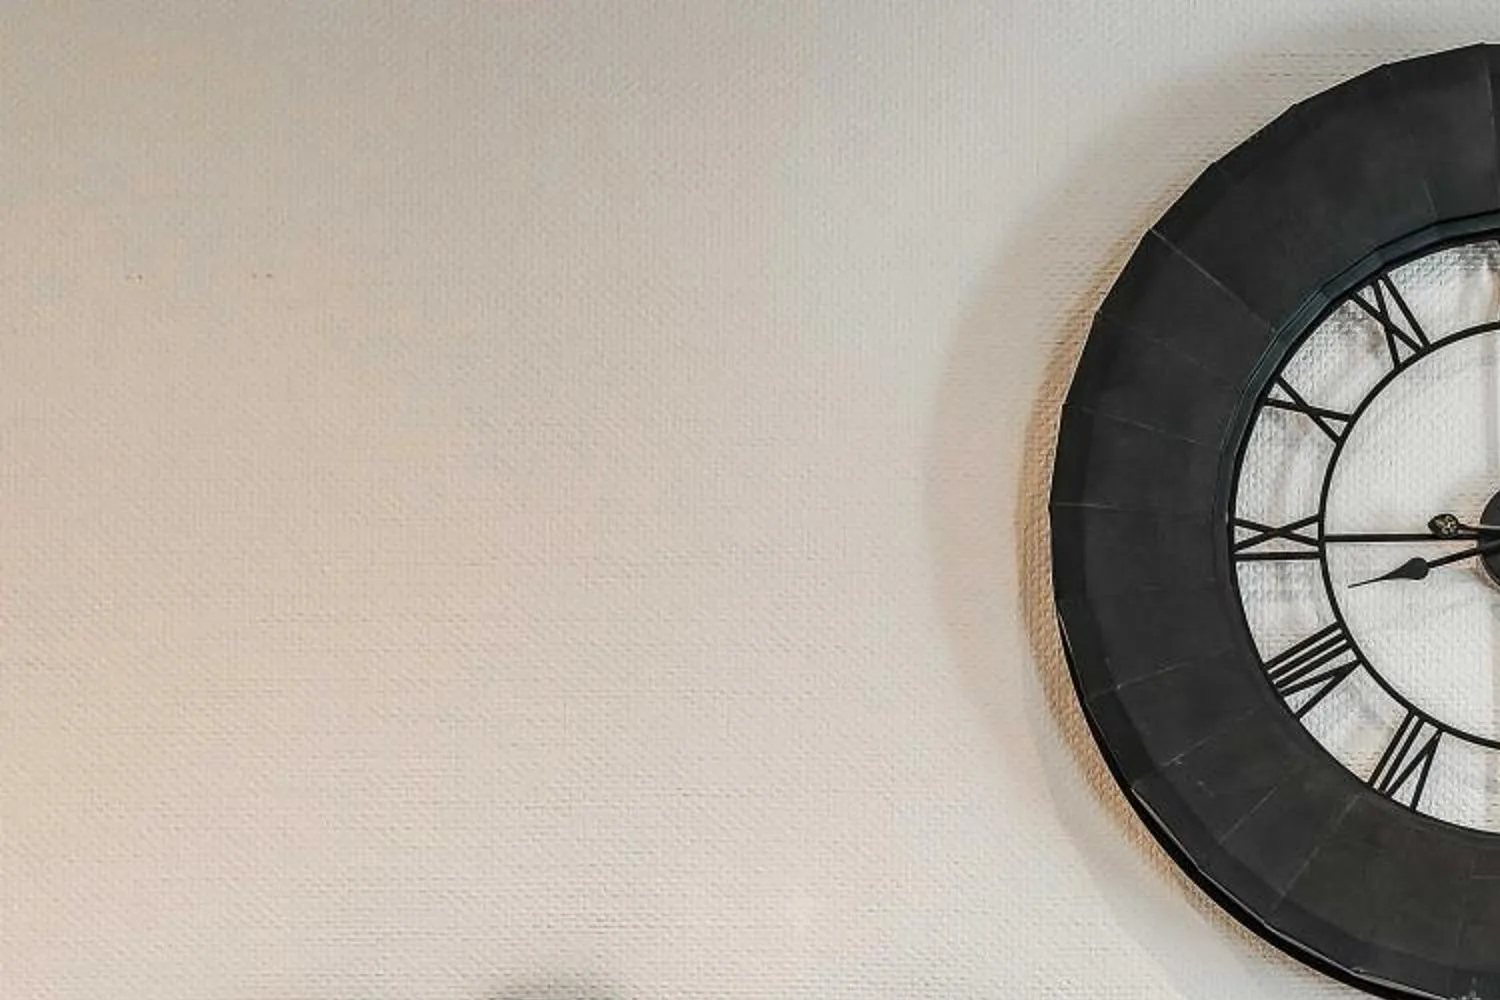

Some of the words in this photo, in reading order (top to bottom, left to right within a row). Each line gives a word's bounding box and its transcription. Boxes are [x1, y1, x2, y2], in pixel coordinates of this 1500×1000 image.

[1348, 271, 1431, 367] XI
[1260, 374, 1353, 442] X
[1231, 510, 1321, 560] IX
[1264, 621, 1363, 719] VIII
[1367, 711, 1441, 809] VII
